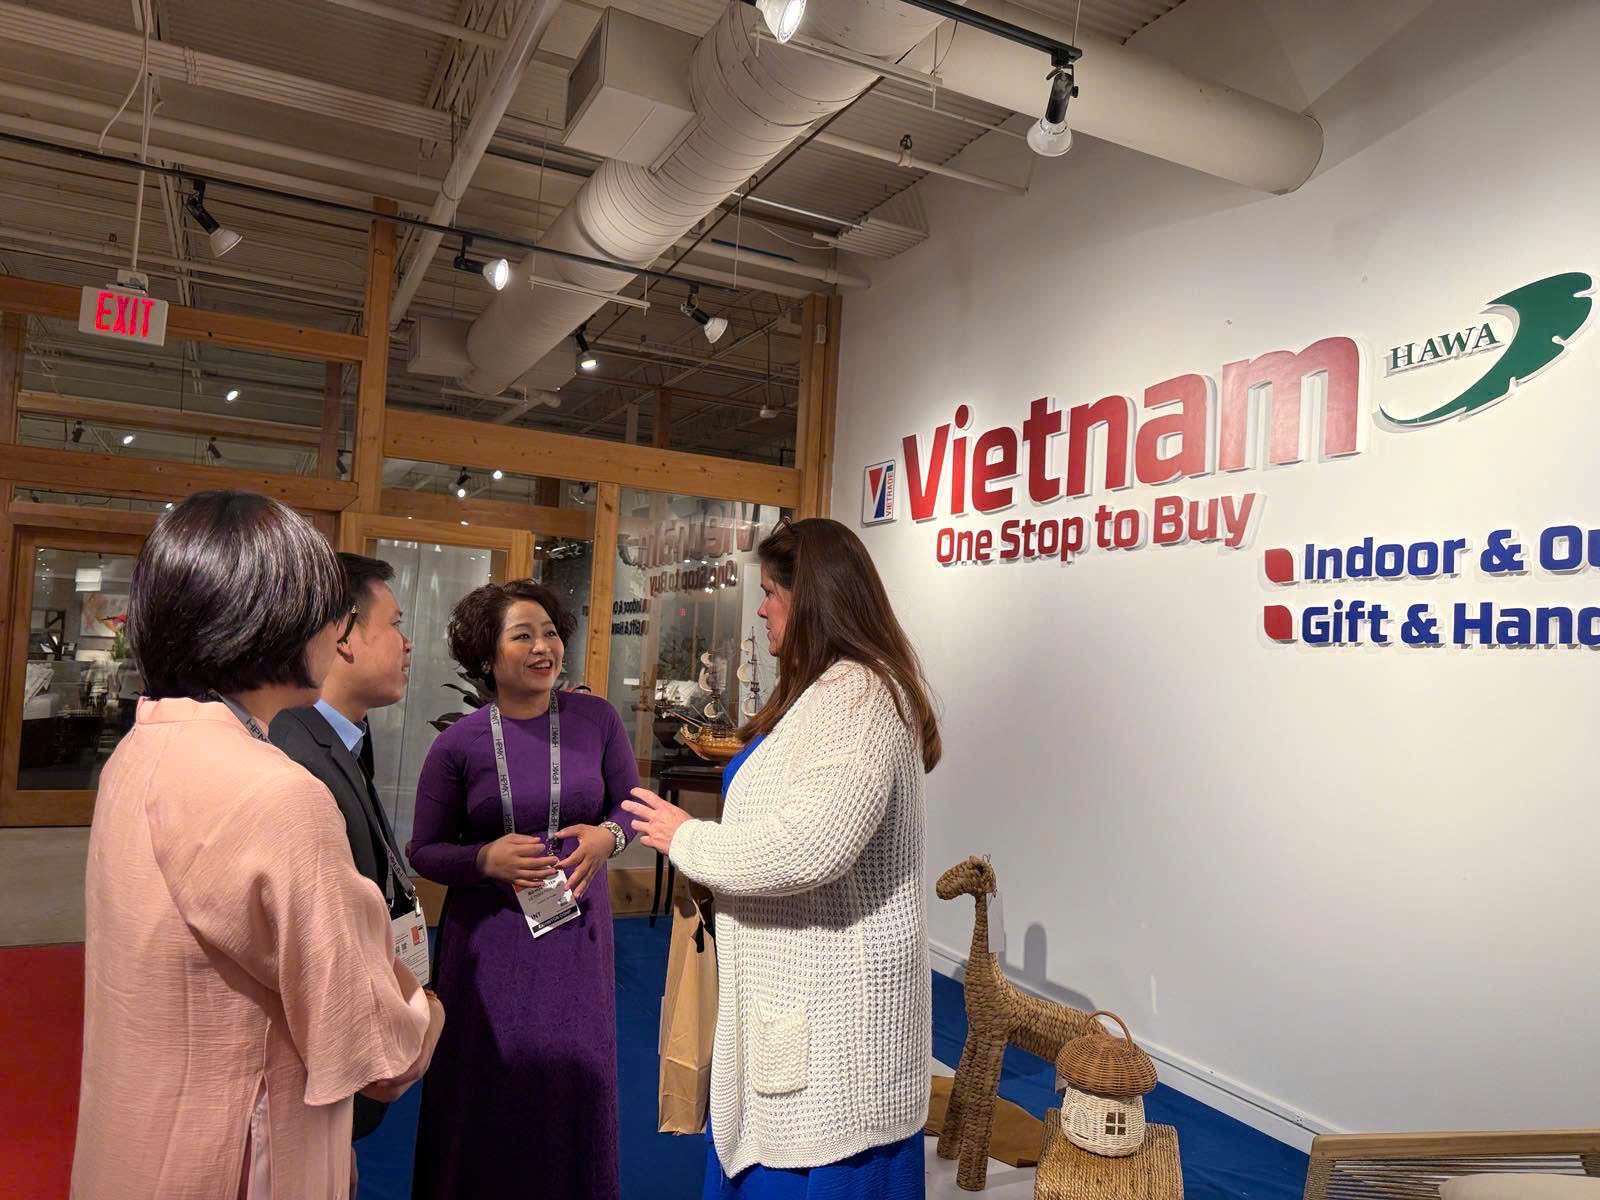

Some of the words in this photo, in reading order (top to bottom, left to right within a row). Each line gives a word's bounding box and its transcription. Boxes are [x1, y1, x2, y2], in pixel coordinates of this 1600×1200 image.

[95, 291, 155, 337] EXIT
[1389, 322, 1501, 371] HAWA
[902, 336, 1359, 522] Vietnam
[886, 471, 894, 517] VIETRADE
[935, 527, 994, 564] One
[1000, 515, 1086, 562] Stop
[1094, 504, 1140, 549] to
[1152, 493, 1257, 549] Buy
[1304, 536, 1466, 580] Indoor
[1480, 529, 1524, 573] &
[1302, 599, 1390, 643] Gift
[1401, 604, 1440, 644] &
[495, 738, 505, 760] HPMKT
[500, 774, 511, 798] HPMKT
[552, 761, 560, 785] HPMKT
[550, 801, 559, 827] HPMKT
